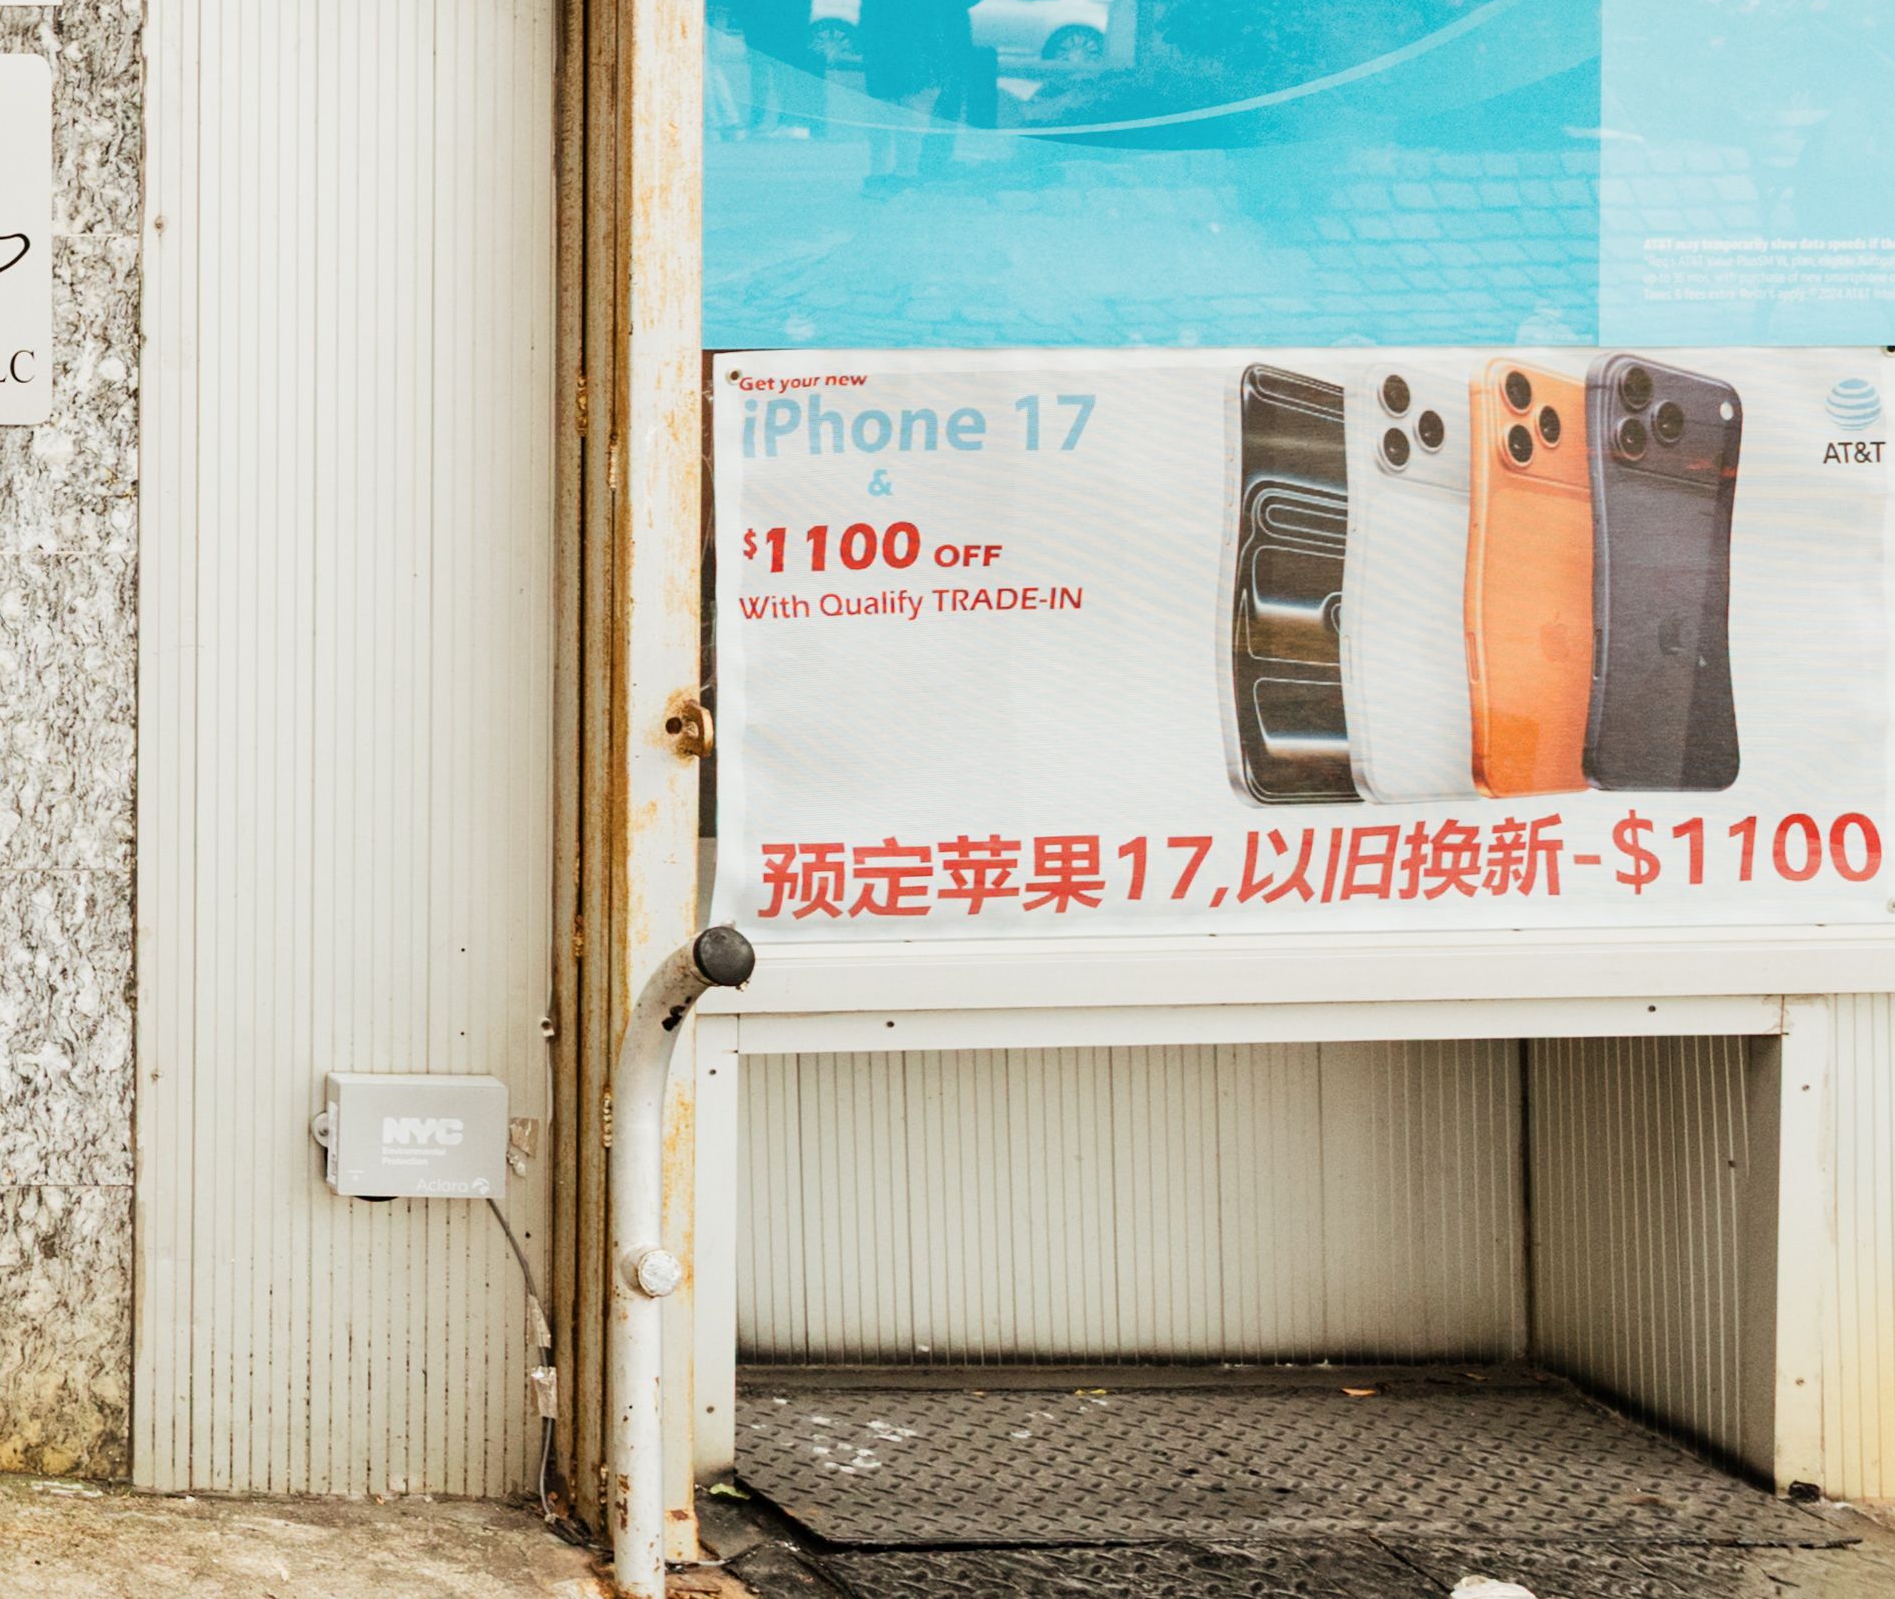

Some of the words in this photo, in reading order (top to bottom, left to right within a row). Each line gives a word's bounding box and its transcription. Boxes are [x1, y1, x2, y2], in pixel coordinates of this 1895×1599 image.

[738, 376, 775, 391] Get
[779, 375, 820, 394] your
[824, 373, 868, 386] new
[742, 393, 987, 458] iPhone
[1014, 394, 1097, 451] 17
[1823, 441, 1886, 464] AT&T
[867, 469, 893, 497] &
[743, 521, 921, 573] $1100
[934, 544, 1003, 568] OFF
[739, 595, 811, 620] With
[820, 590, 924, 621] Qualify
[932, 587, 1084, 612] TRADE-IN
[382, 1117, 464, 1145] NYC
[416, 1177, 468, 1193] Aclara
